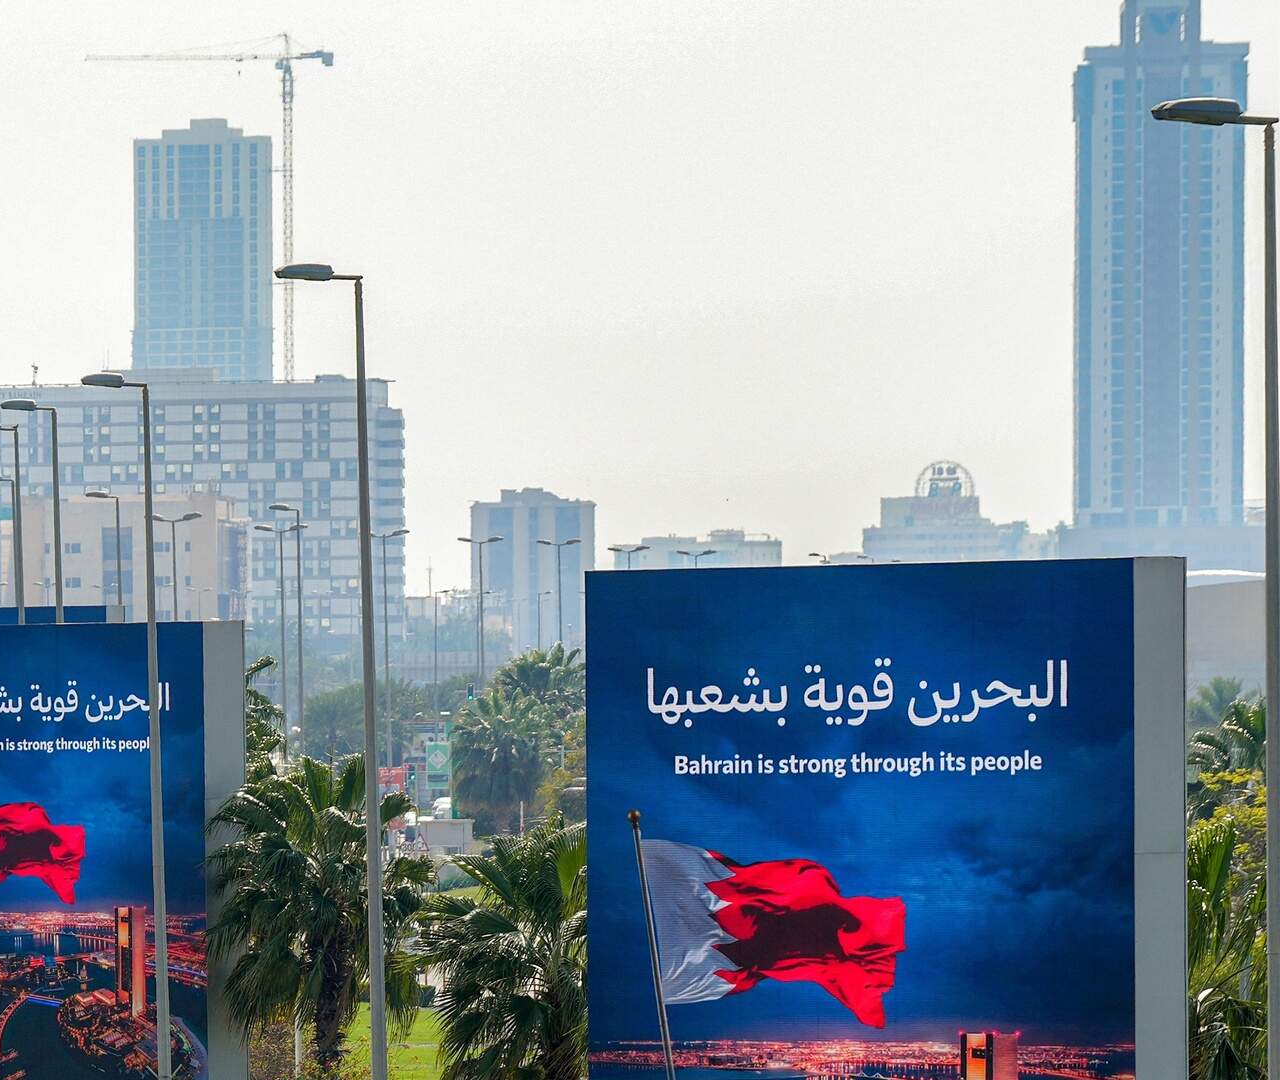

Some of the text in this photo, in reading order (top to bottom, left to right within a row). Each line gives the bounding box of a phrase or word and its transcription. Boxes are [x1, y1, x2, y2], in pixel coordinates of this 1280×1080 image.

[31, 681, 78, 722] قوية
[86, 683, 170, 722] الحرين
[647, 658, 1067, 728] البحرين قوية بشعبها
[6, 738, 15, 751] is
[17, 739, 54, 753] strong
[56, 737, 100, 752] through
[103, 737, 117, 750] its
[119, 737, 150, 752] peopl
[674, 750, 1042, 778] Bahrain is strong through its people
